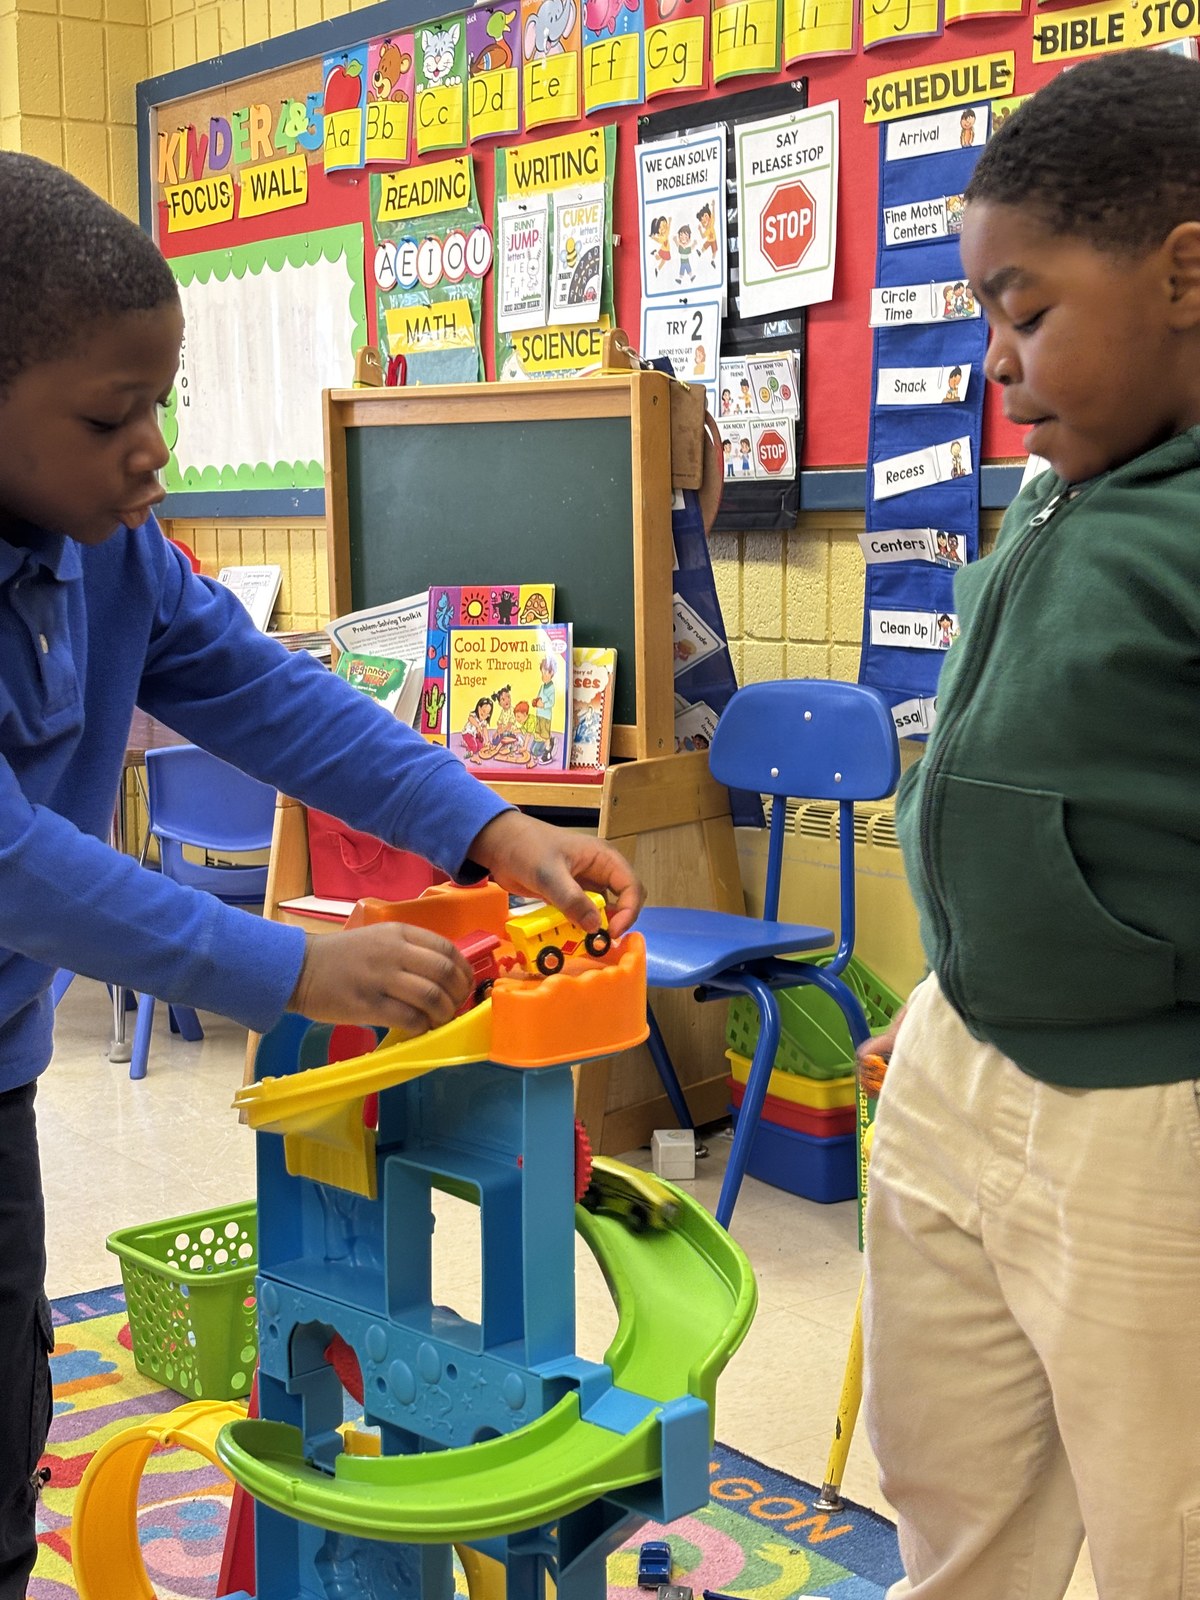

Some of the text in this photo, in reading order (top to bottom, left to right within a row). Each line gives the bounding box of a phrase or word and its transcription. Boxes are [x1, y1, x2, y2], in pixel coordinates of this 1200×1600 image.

[717, 5, 758, 54] Hh
[1040, 0, 1200, 56] BIBLE STO
[589, 41, 622, 87] Ff
[647, 29, 689, 83] Gg
[472, 73, 504, 117] Dd
[530, 63, 560, 103] Ee
[870, 60, 1009, 115] SCHEDULE
[366, 105, 394, 140] Bb
[419, 91, 449, 128] Cc
[158, 104, 274, 185] KINDER
[324, 118, 350, 148] Aa
[776, 130, 799, 148] SAY
[899, 126, 940, 147] Arrival
[514, 146, 599, 189] WRITING
[645, 146, 718, 174] WE CAN SOLVE
[752, 146, 824, 175] PLEASE STOP
[171, 166, 303, 219] FOCUS WALL
[385, 172, 467, 212] READING
[656, 169, 709, 192] PROBLEMS!
[514, 218, 536, 232] BUNNY
[563, 205, 599, 228] CURVE
[765, 207, 812, 244] STOP
[885, 203, 944, 225] Fine Motor
[508, 229, 540, 252] JUMP
[893, 222, 938, 240] Centers
[880, 289, 917, 304] Circle
[666, 310, 703, 341] TRY 2
[884, 307, 913, 321] Time
[406, 313, 457, 344] MATH
[522, 328, 601, 363] SCIENCE
[894, 378, 927, 394] Snack
[760, 443, 785, 460] STOP
[886, 464, 925, 485] Recess
[871, 537, 926, 553] Centers
[352, 611, 422, 634] Problem-Solving Toolkit
[676, 611, 708, 646] being rude
[879, 620, 928, 639] Clean Up
[454, 638, 487, 653] Cool
[490, 637, 529, 652] Down
[530, 642, 546, 652] and
[454, 657, 533, 674] Work Through
[454, 674, 488, 687] Anger
[573, 677, 601, 689] ses
[894, 710, 922, 728] ssal
[709, 1462, 854, 1544] GON
